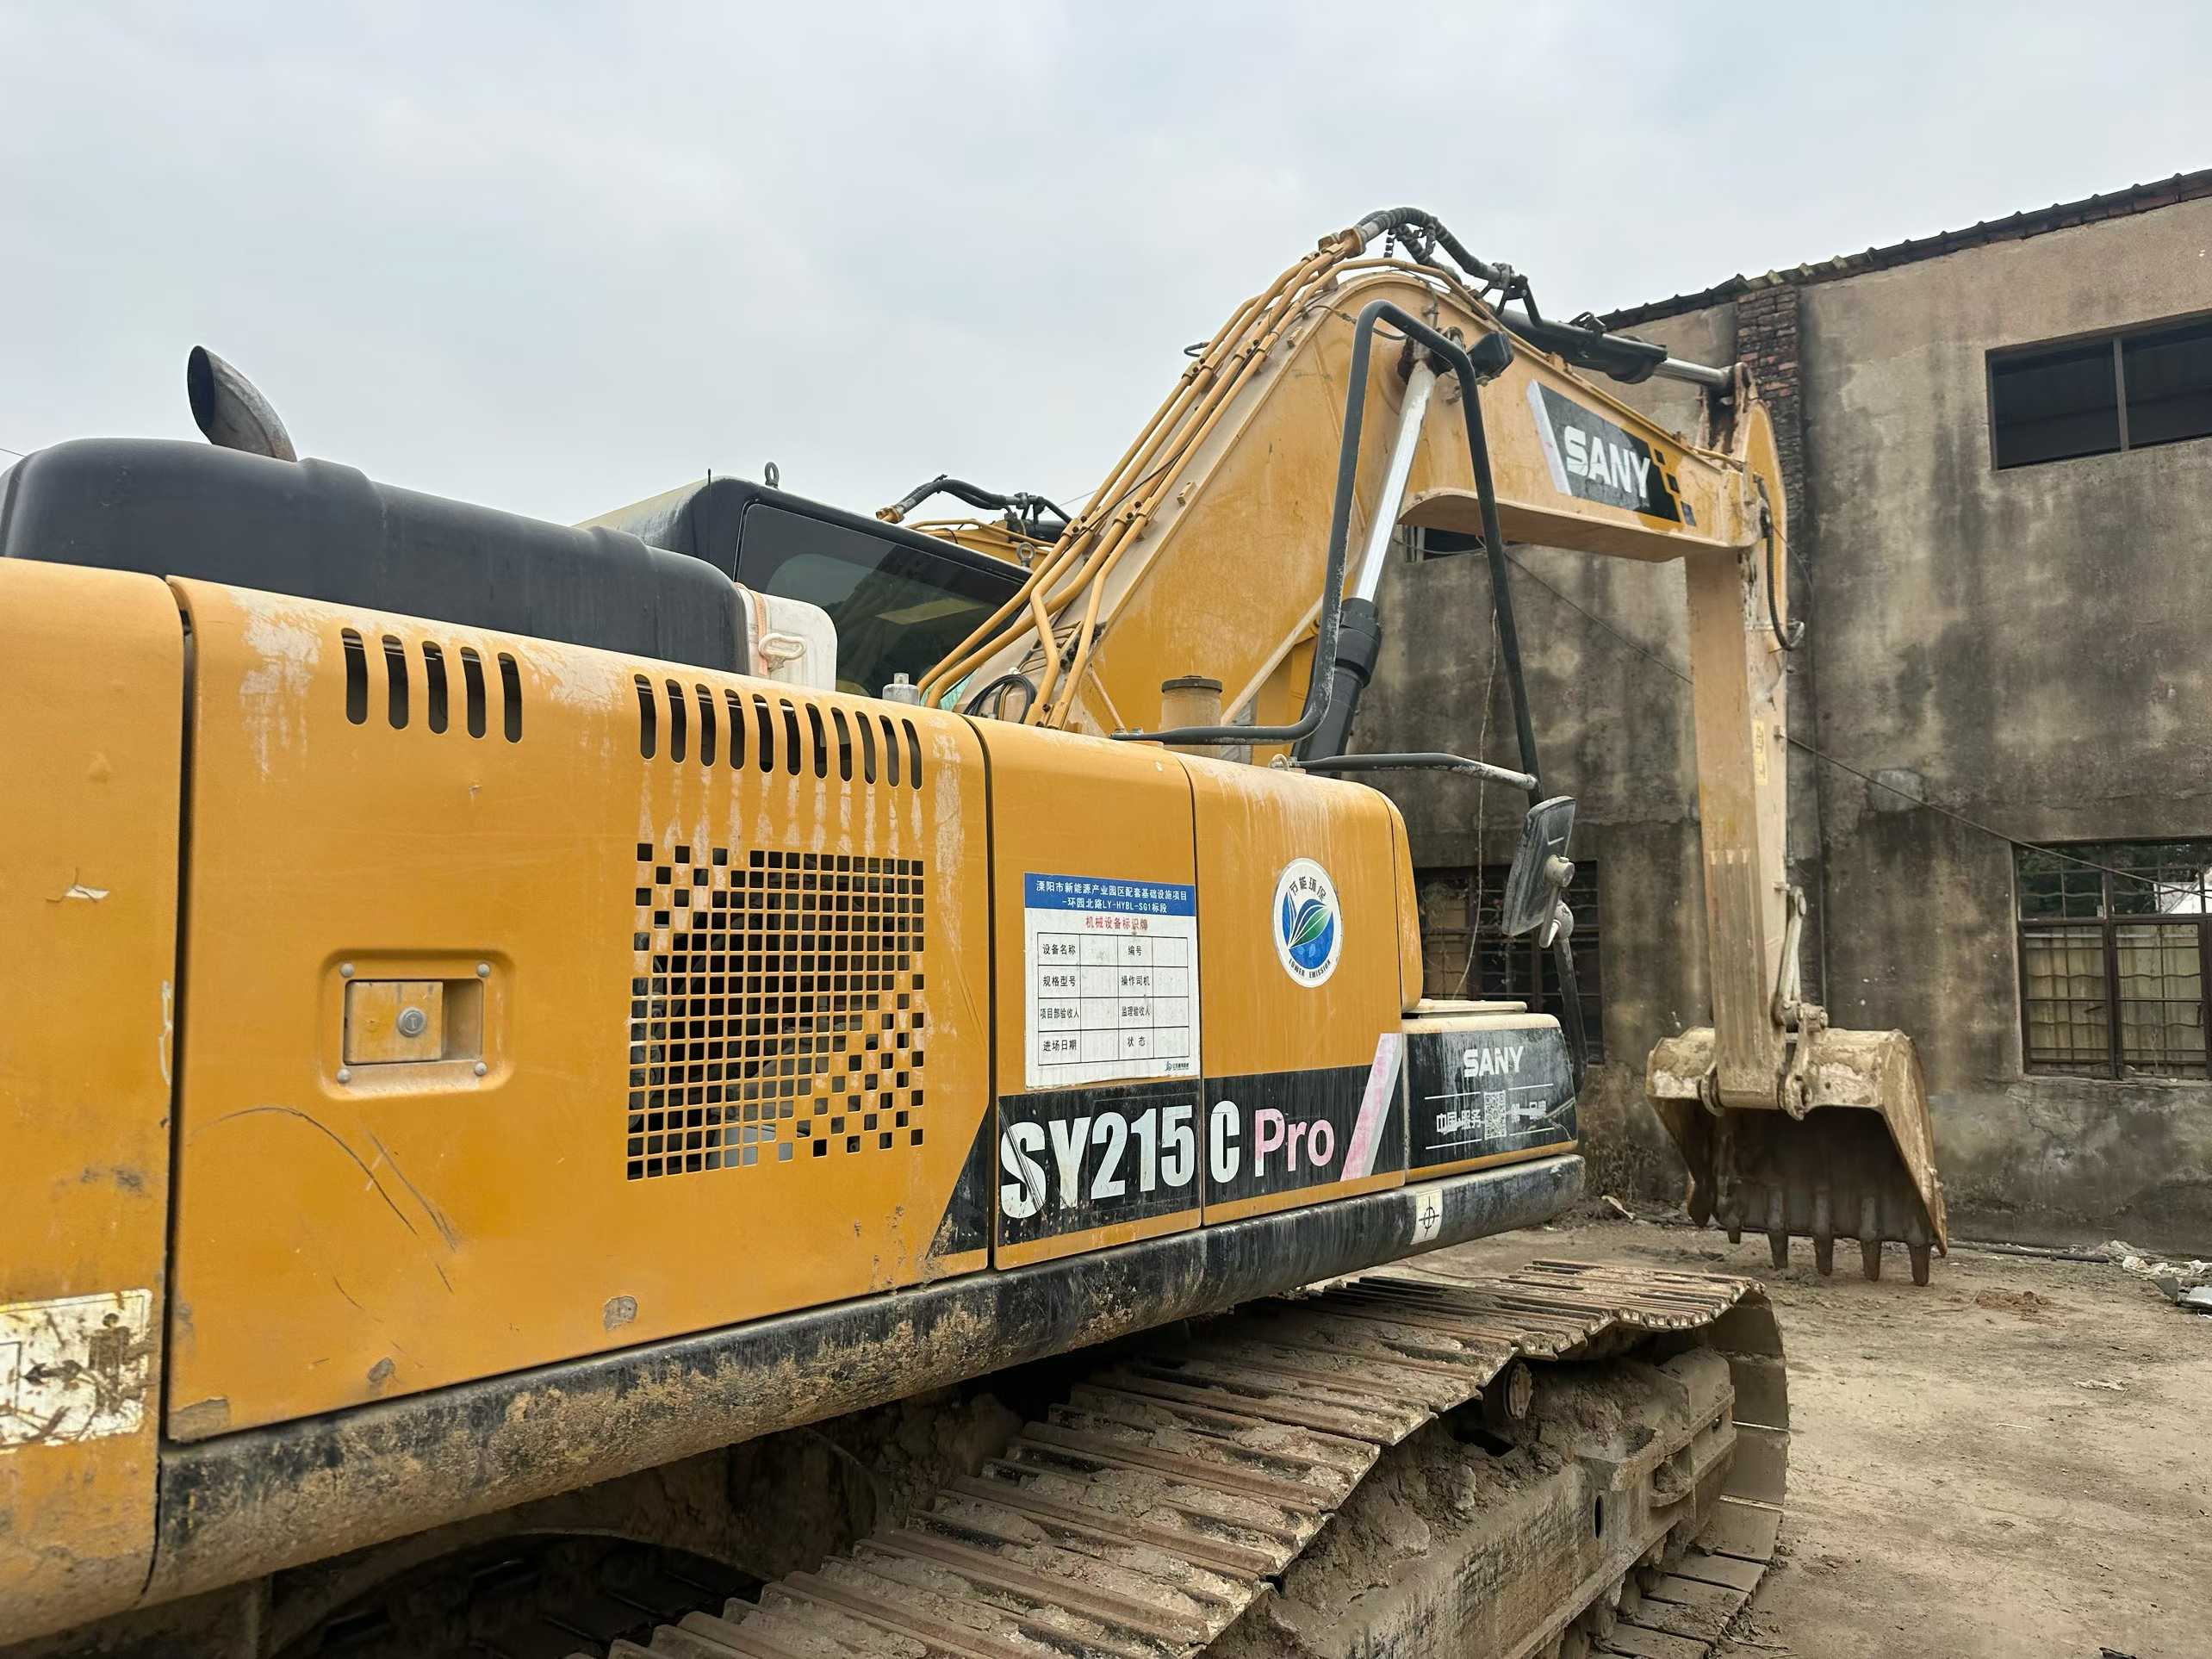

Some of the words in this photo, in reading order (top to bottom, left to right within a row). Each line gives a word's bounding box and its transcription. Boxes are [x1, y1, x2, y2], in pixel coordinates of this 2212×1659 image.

[1564, 426, 1650, 498] SANY
[1085, 916, 1148, 931] 机械设备标识牌
[1042, 943, 1076, 955] 设备名称
[1128, 945, 1142, 956] 编号
[1042, 975, 1076, 987] 规格型号
[1121, 975, 1150, 986] 操作司机
[1040, 1007, 1079, 1019] 项目部验收人
[1043, 1039, 1077, 1052] 进场日期
[1463, 1046, 1524, 1078] SANY
[1255, 1108, 1335, 1177] Pro
